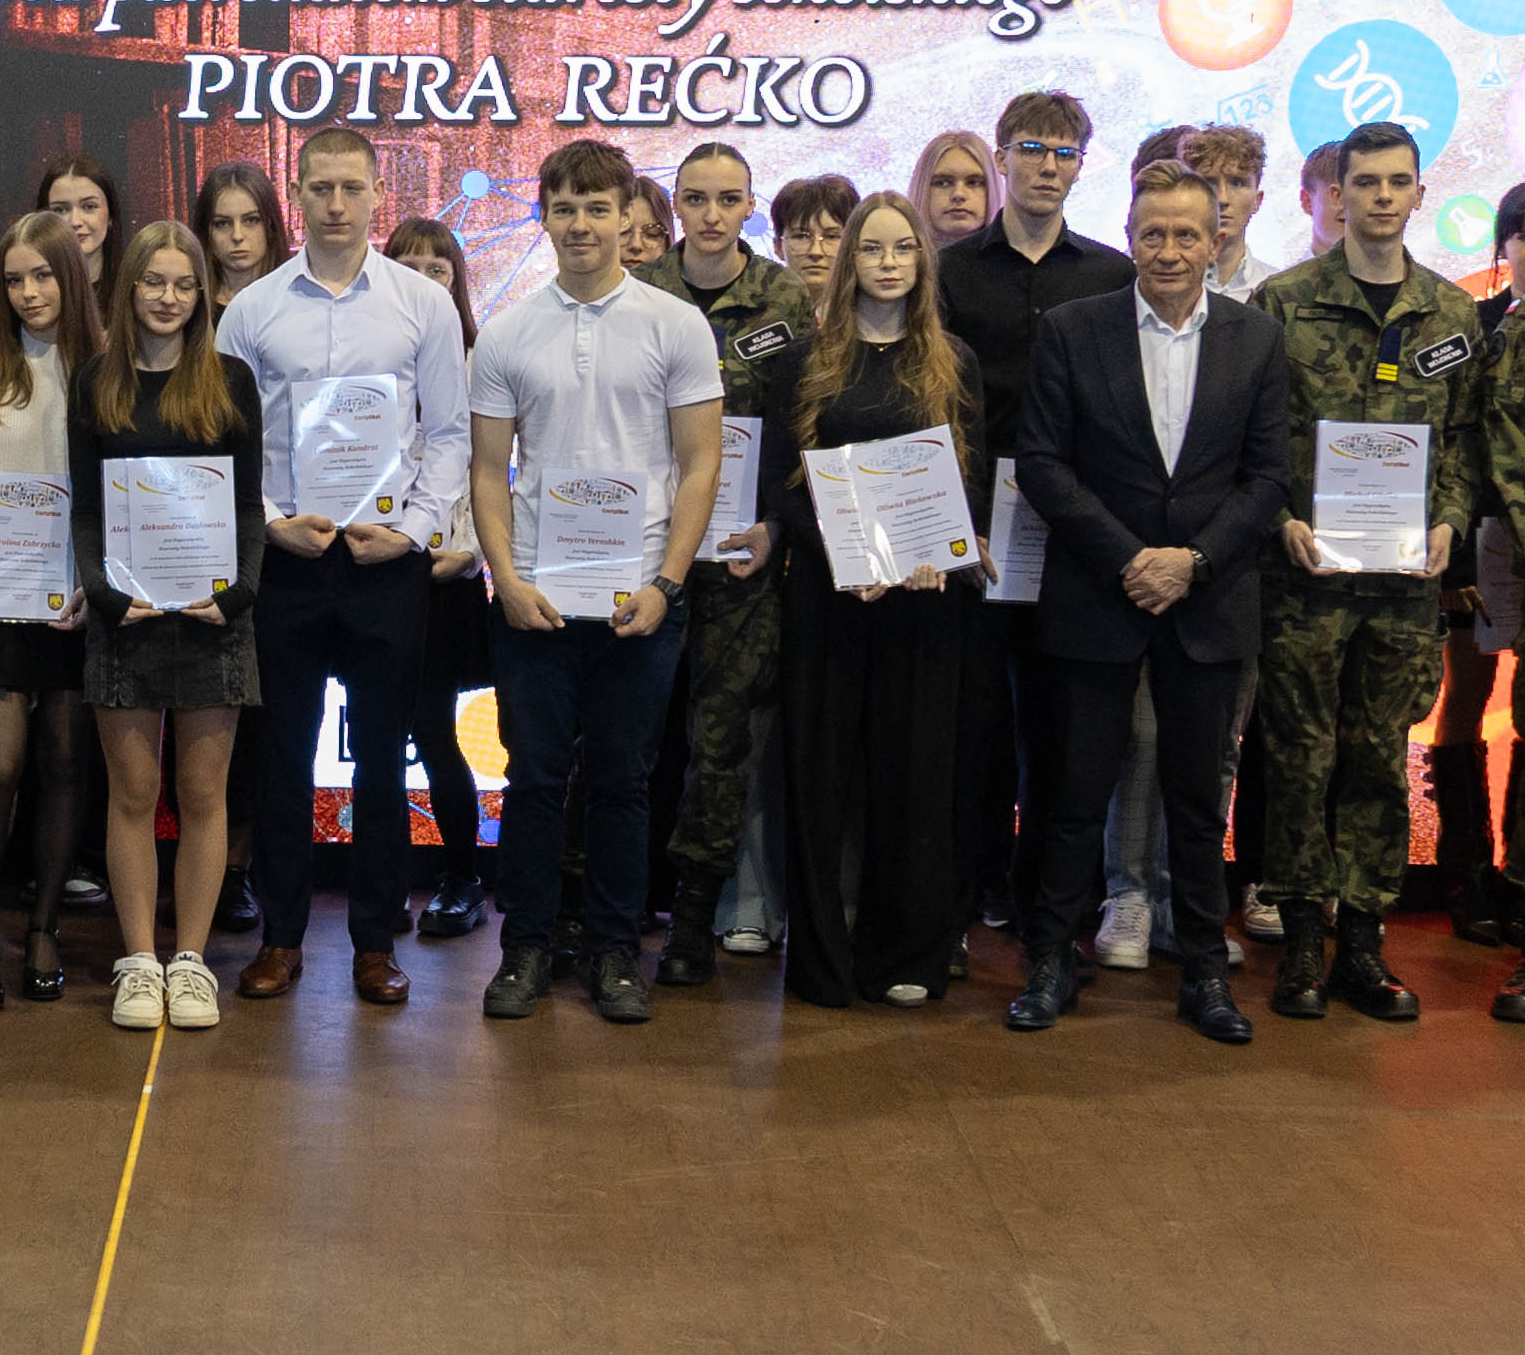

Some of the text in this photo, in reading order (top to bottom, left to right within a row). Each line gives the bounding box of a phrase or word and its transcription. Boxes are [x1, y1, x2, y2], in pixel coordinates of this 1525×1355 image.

[178, 32, 868, 125] PIOTRA REĆKO
[752, 331, 775, 344] KLASA
[1431, 345, 1454, 359] KLASA
[110, 525, 130, 534] Alek
